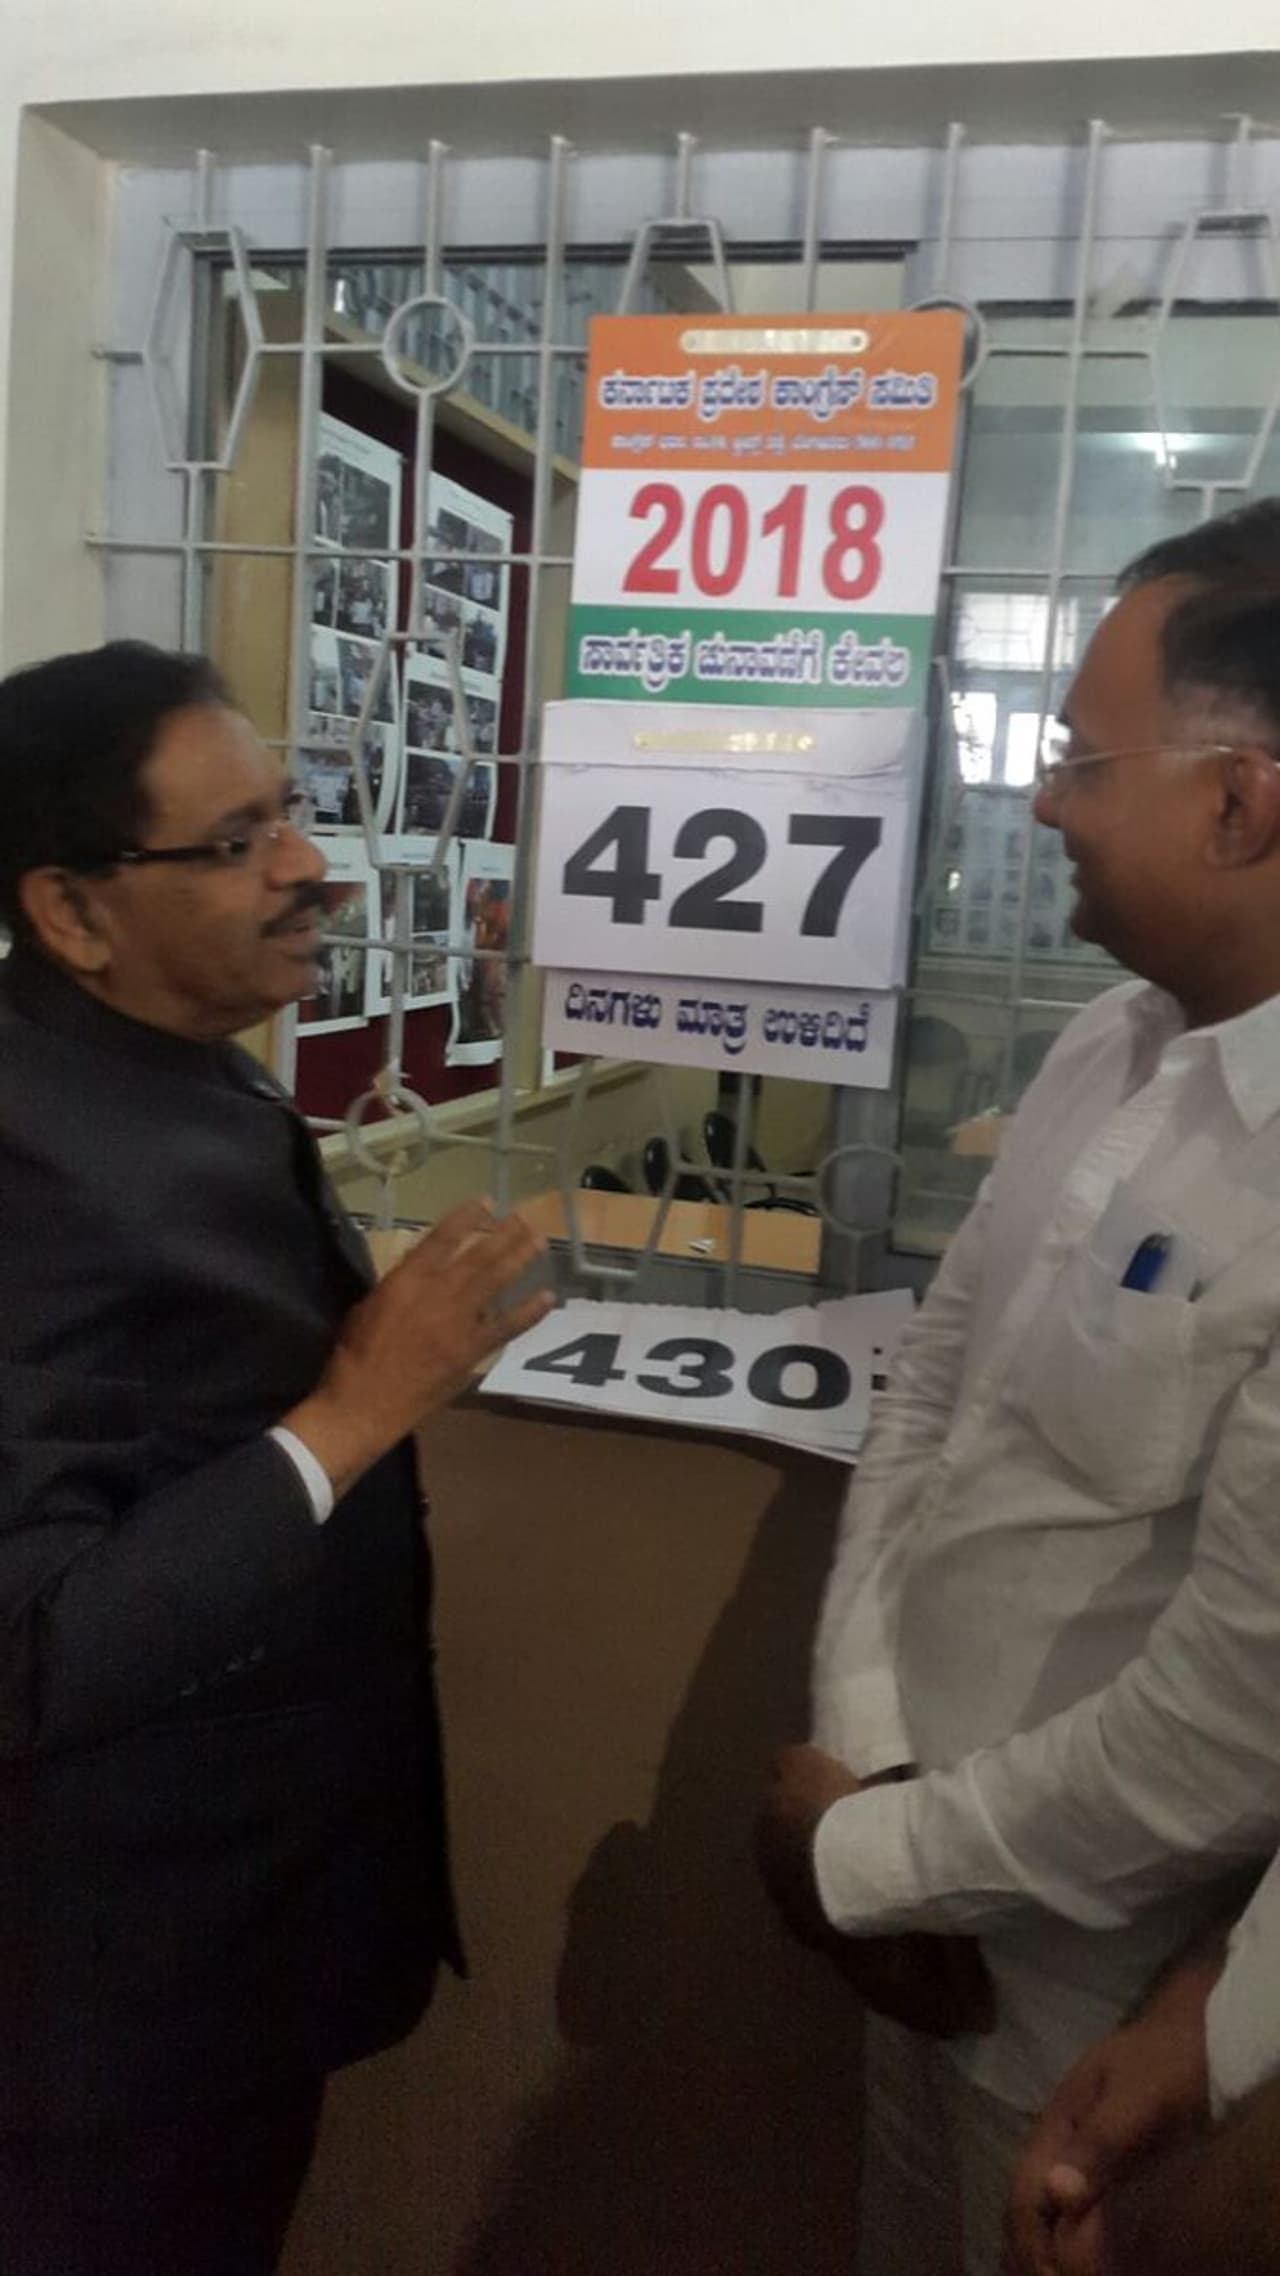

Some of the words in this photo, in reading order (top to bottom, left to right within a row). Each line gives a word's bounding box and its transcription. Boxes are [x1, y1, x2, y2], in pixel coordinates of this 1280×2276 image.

[622, 482, 885, 600] 2018
[562, 805, 883, 937] 427
[565, 982, 662, 1029] ದಿನಗಳು
[677, 1000, 748, 1055] ಮಾತ್ರ
[522, 1332, 852, 1410] 430
